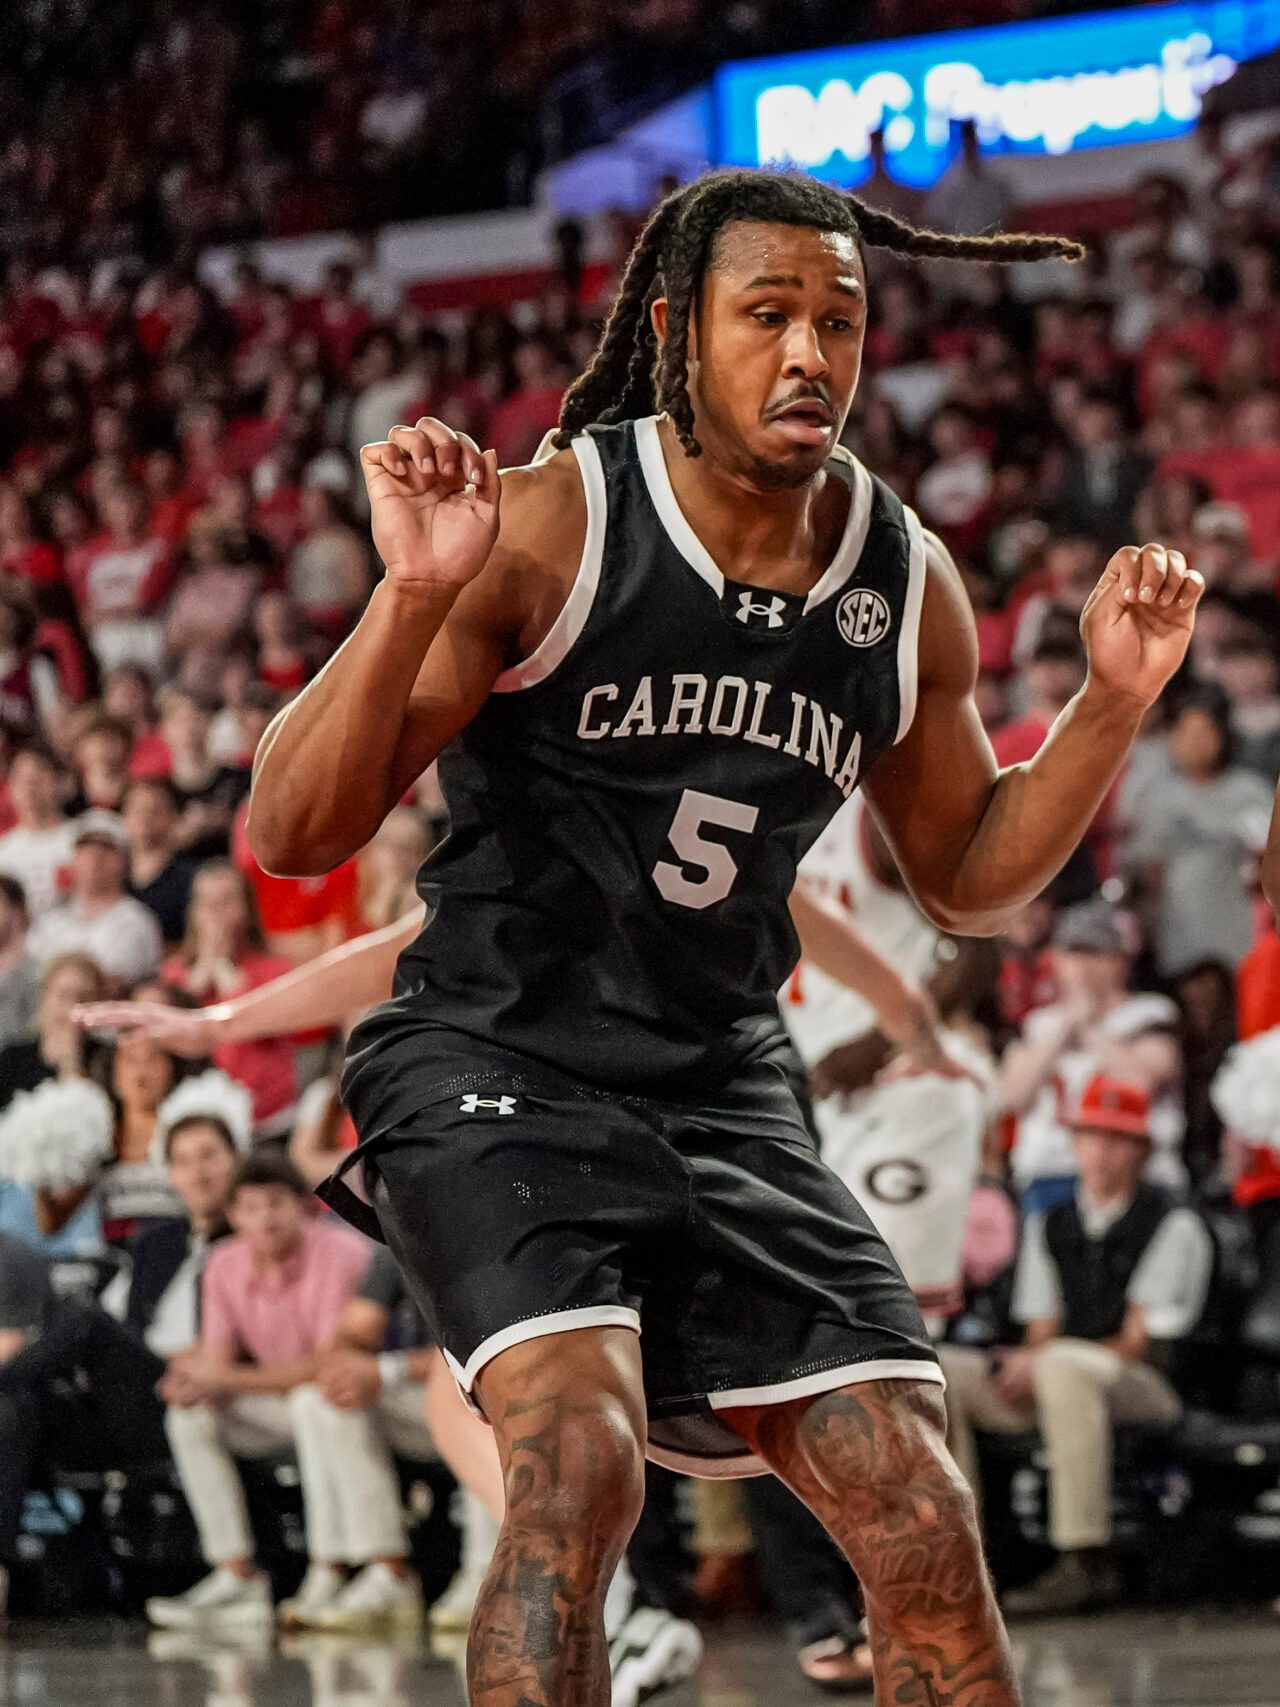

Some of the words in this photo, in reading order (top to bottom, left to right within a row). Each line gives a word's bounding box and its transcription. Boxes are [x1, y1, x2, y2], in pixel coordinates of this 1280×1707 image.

[840, 592, 887, 643] SEC
[577, 673, 862, 799] CAROLINA
[652, 788, 759, 910] 5
